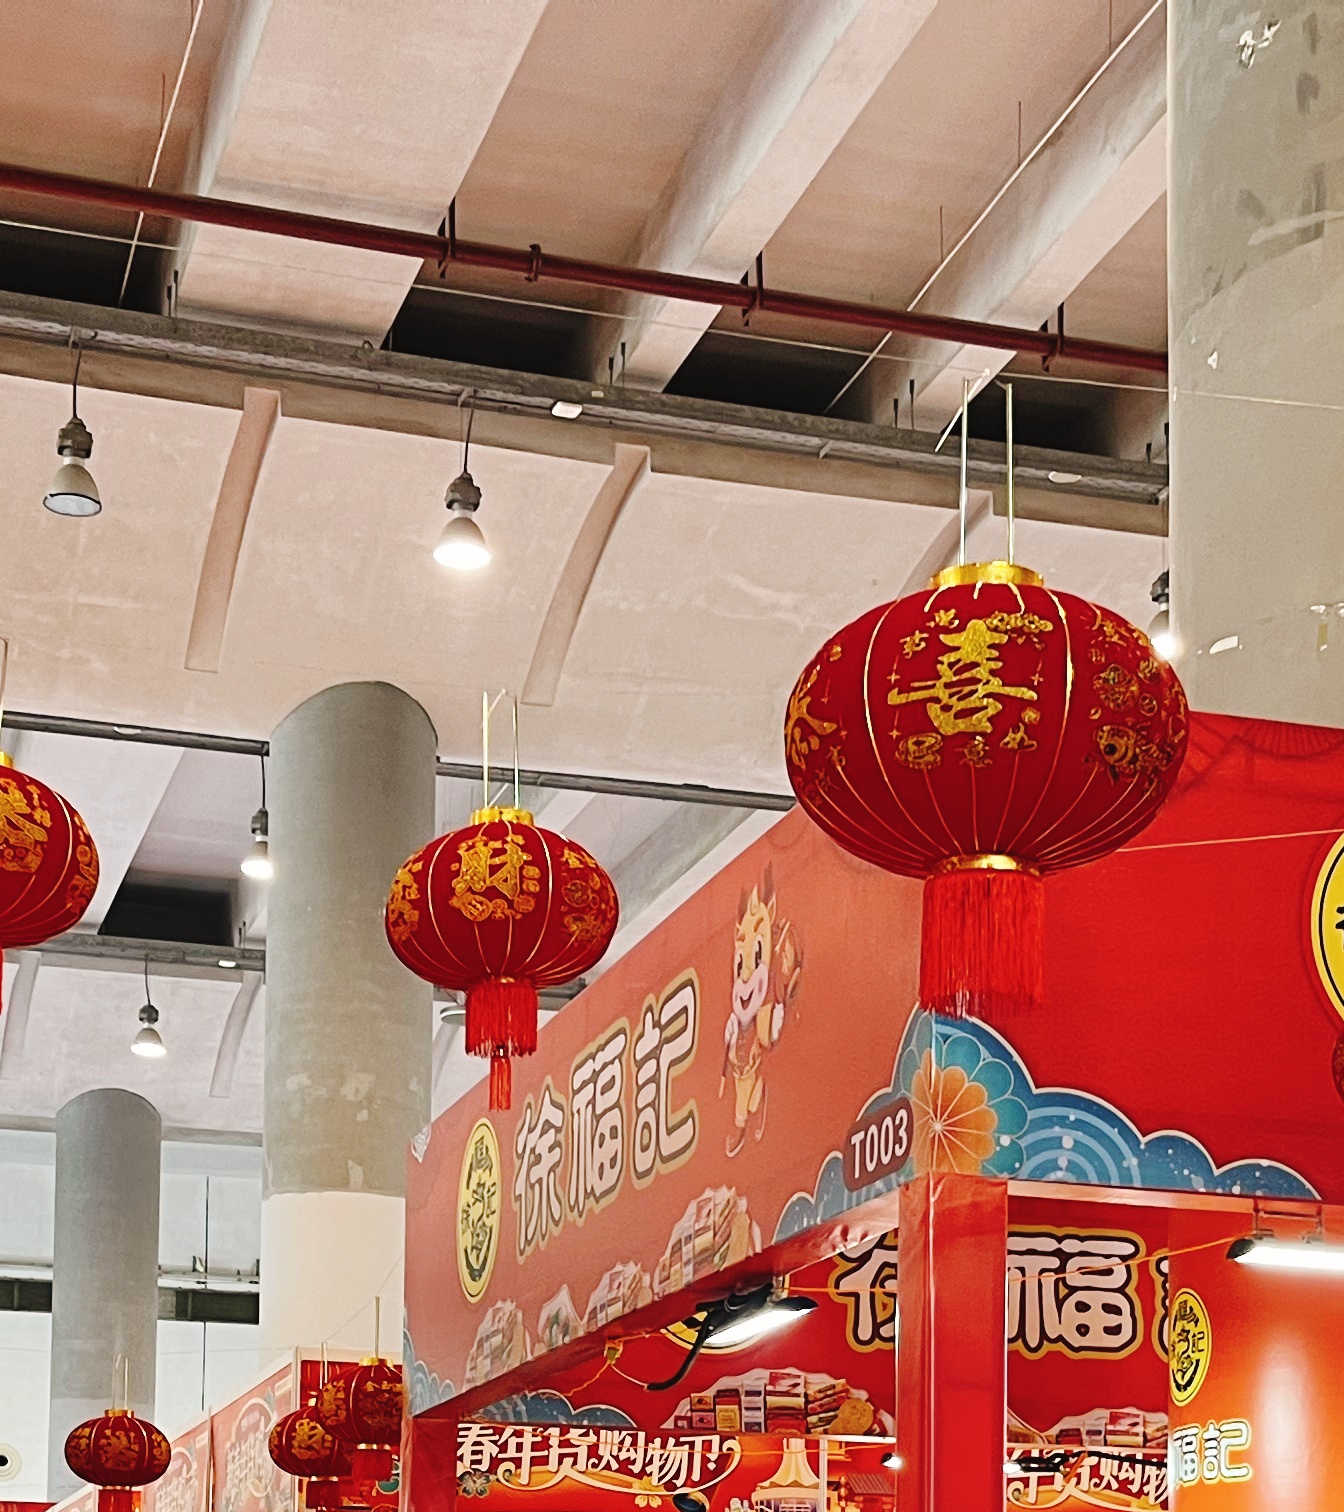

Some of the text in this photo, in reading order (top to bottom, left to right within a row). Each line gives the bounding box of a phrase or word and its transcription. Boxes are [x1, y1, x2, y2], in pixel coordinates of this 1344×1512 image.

[888, 619, 1038, 736] 喜
[849, 1107, 911, 1182] T003
[837, 1232, 1170, 1358] 徐福
